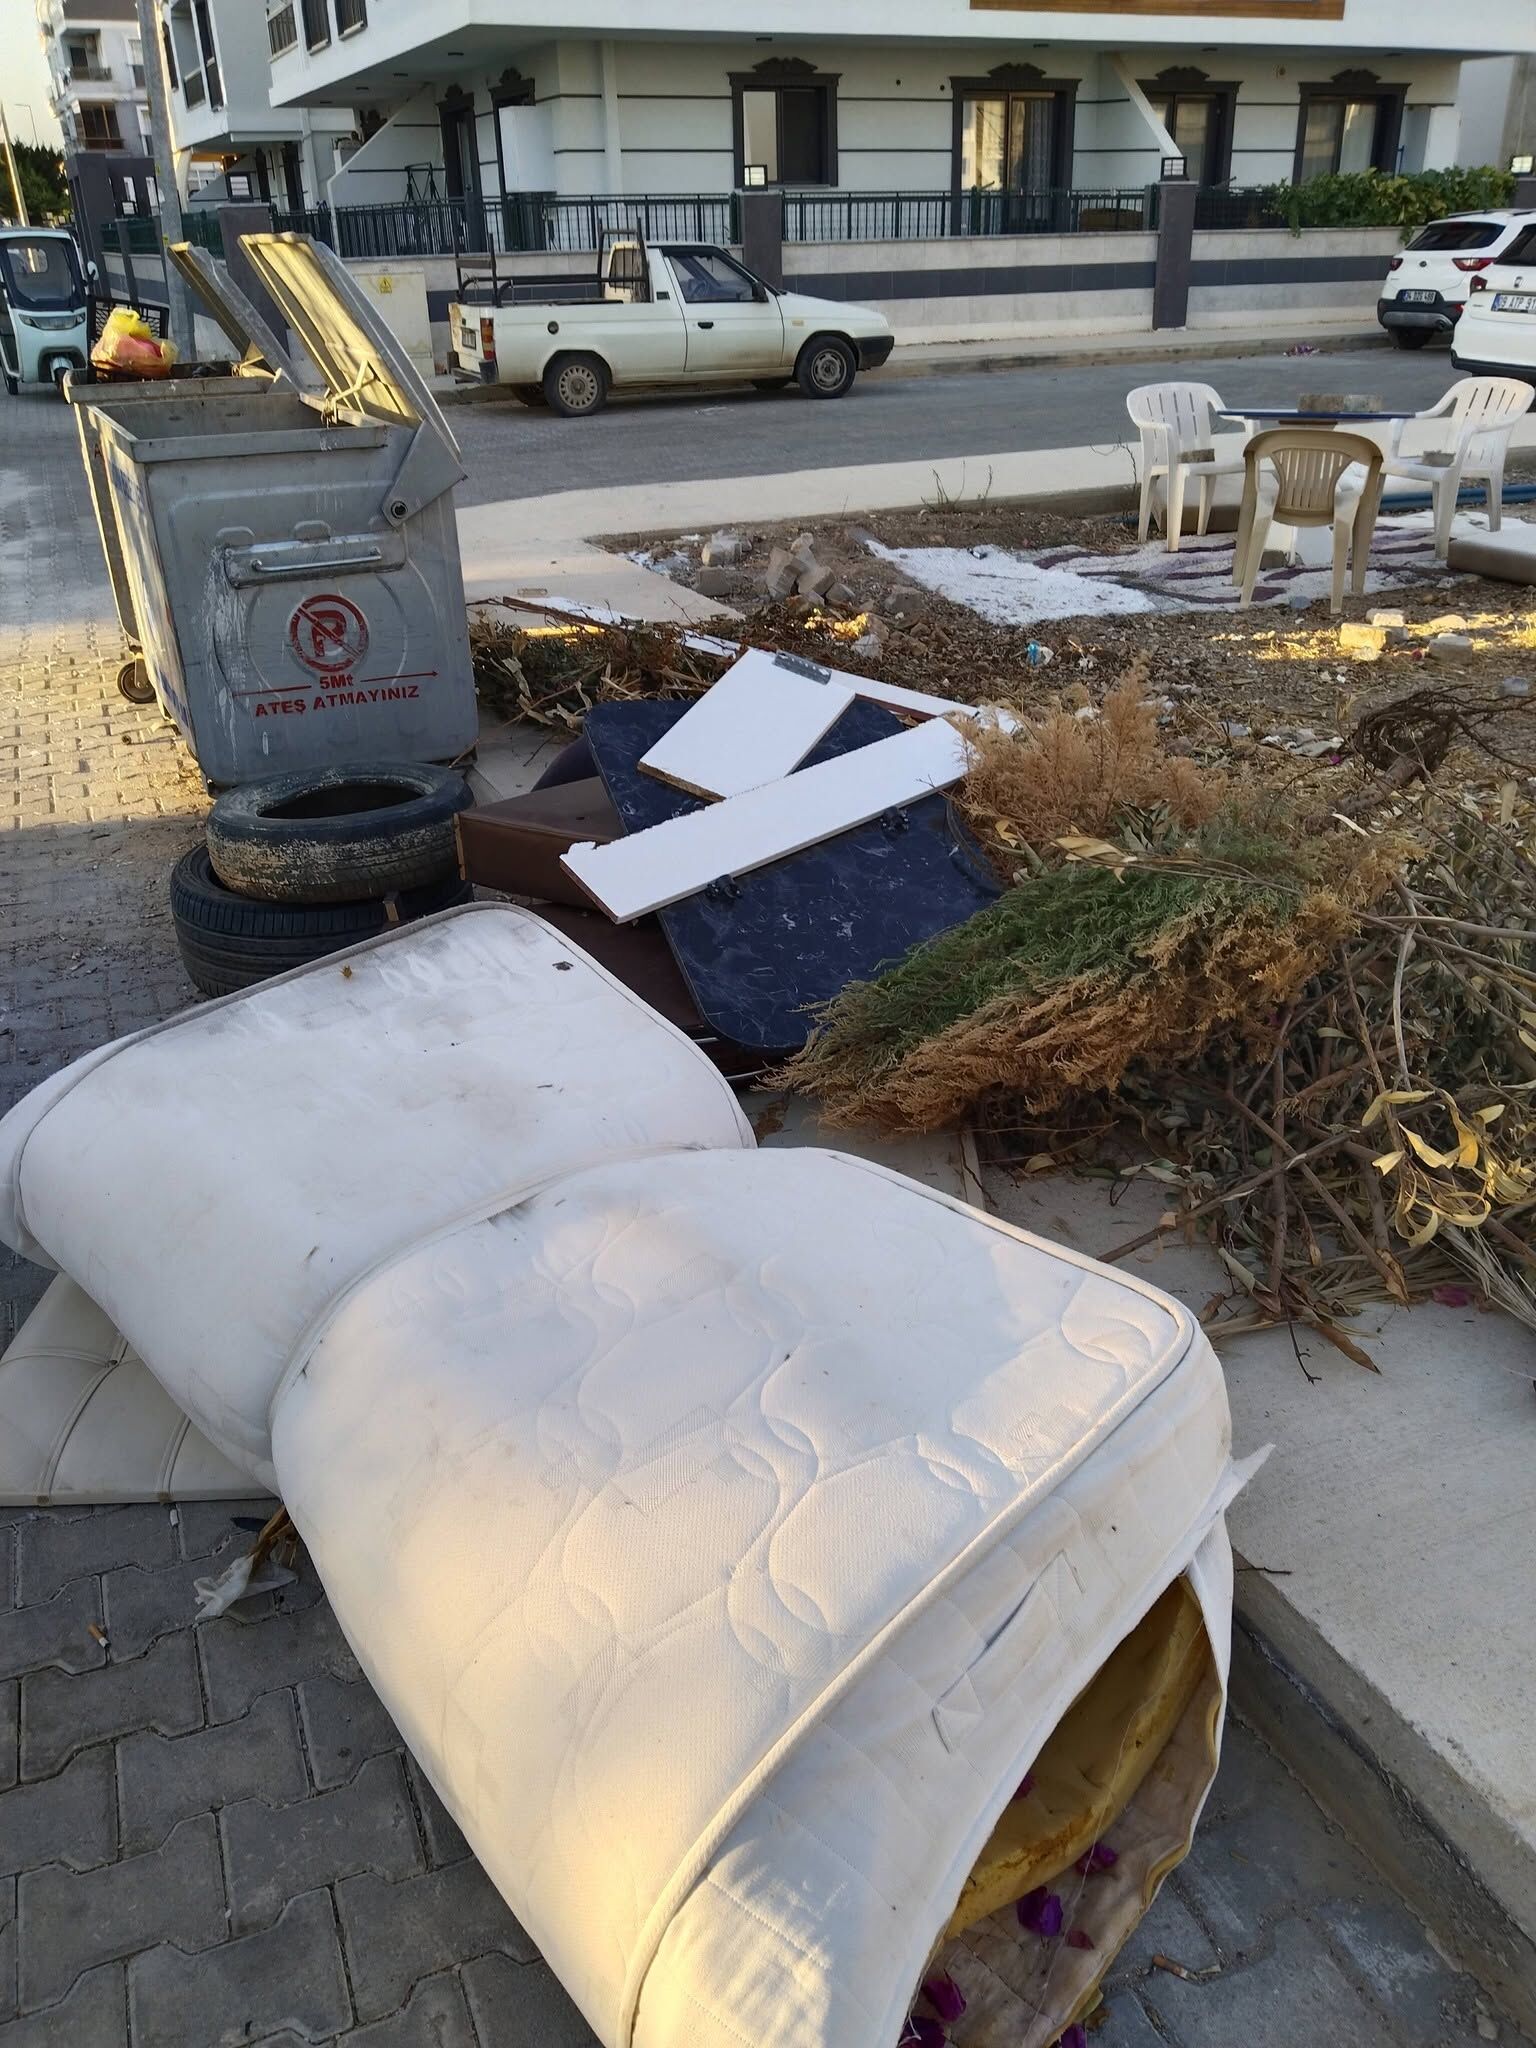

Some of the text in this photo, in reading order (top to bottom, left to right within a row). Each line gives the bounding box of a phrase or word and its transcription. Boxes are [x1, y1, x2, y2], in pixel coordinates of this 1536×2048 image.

[1509, 297, 1524, 309] ATP
[319, 674, 354, 690] 5Mt
[255, 685, 420, 717] ATEŞ ATMAYINIZ
